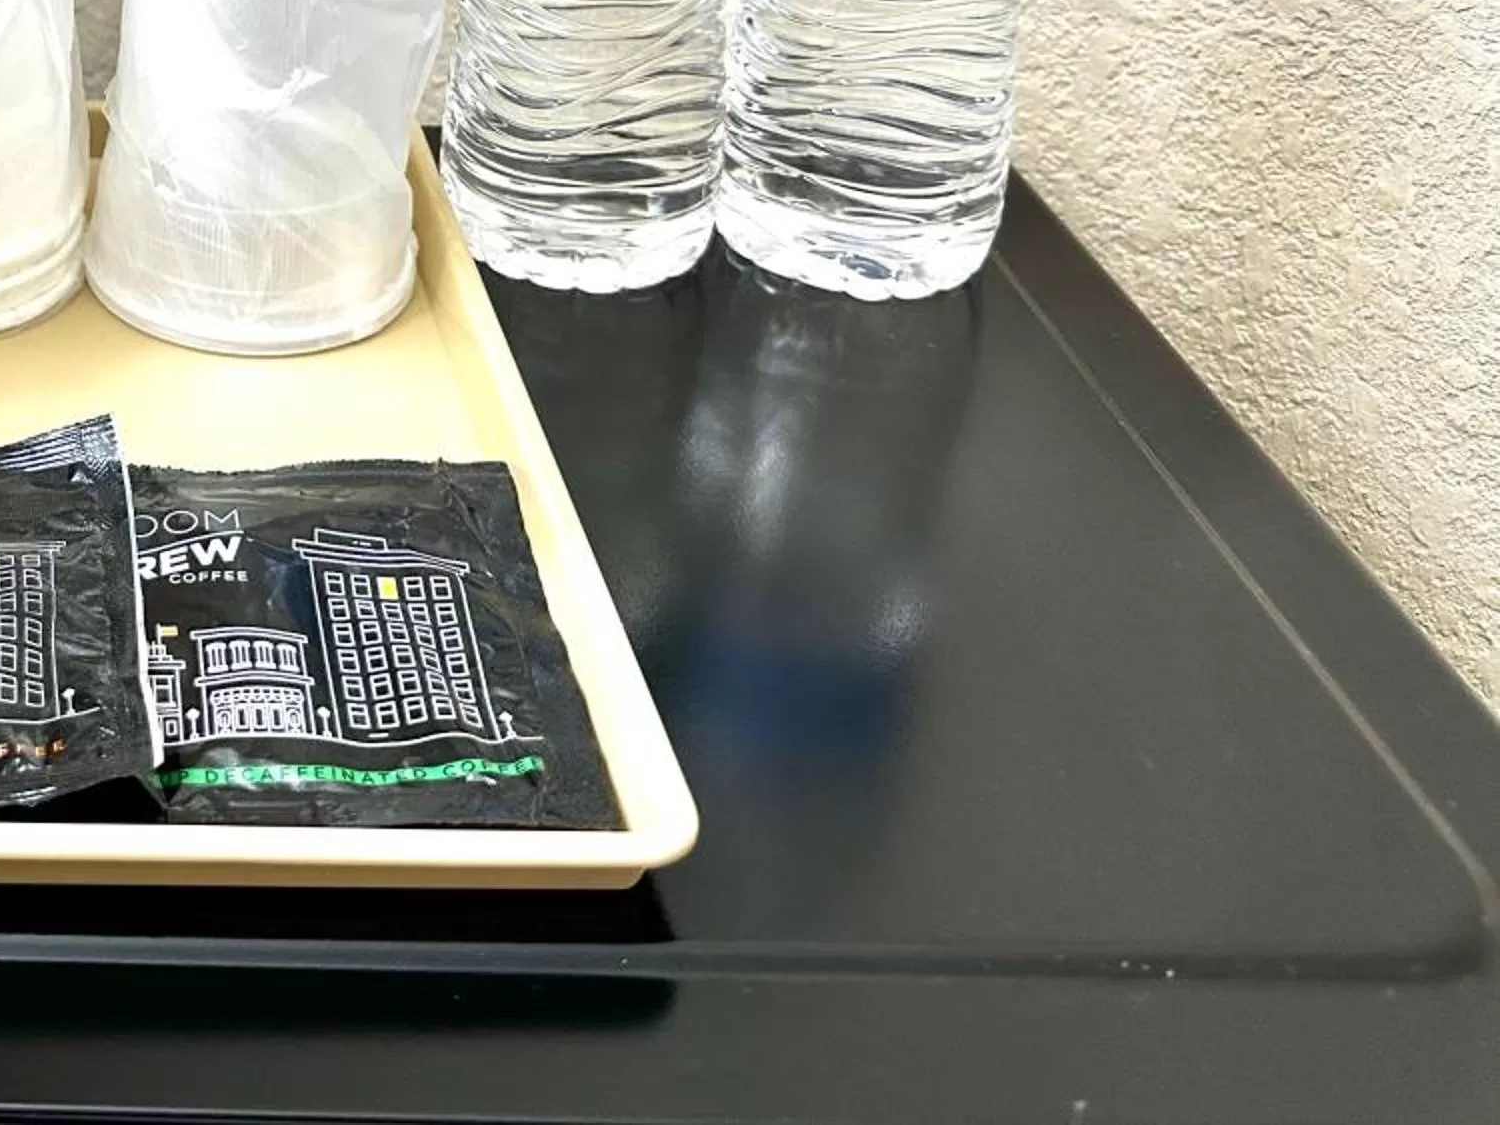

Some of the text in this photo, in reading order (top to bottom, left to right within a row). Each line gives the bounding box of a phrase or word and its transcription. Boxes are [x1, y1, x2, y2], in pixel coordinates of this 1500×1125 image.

[134, 508, 241, 538] OOM
[136, 536, 242, 580] REW
[169, 570, 249, 584] COFFEE
[204, 766, 428, 785] DECAFFEINATED
